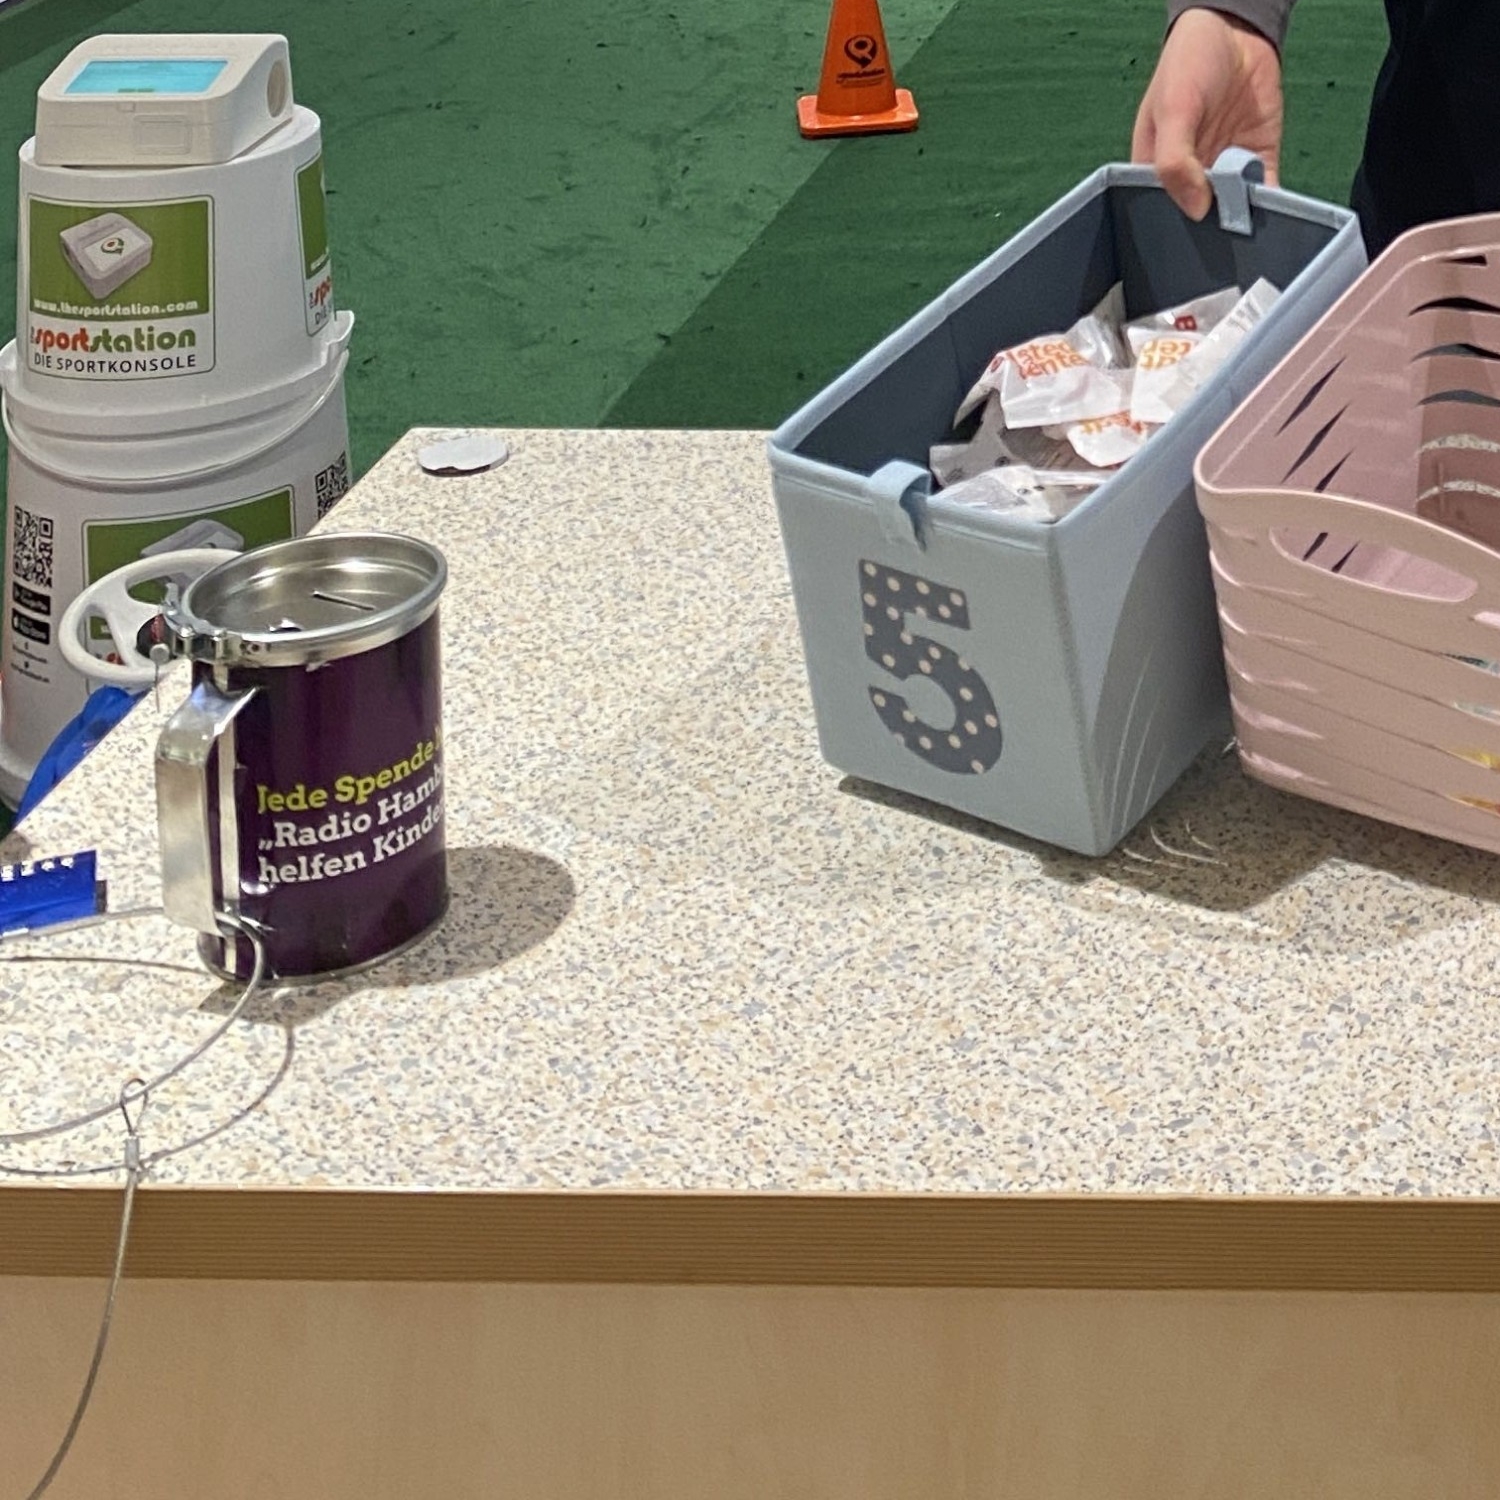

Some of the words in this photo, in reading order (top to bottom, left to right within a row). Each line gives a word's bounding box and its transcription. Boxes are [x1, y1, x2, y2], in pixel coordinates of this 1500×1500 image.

[33, 298, 198, 318] www.thesportstation.com
[35, 325, 197, 353] sportstation
[34, 353, 52, 368] DIE
[56, 354, 197, 373] SPORTKONSOLE
[858, 558, 1003, 775] 5
[256, 783, 328, 815] Jede
[334, 740, 435, 806] Spende
[258, 811, 372, 851] „Radio
[258, 849, 368, 884] helfen
